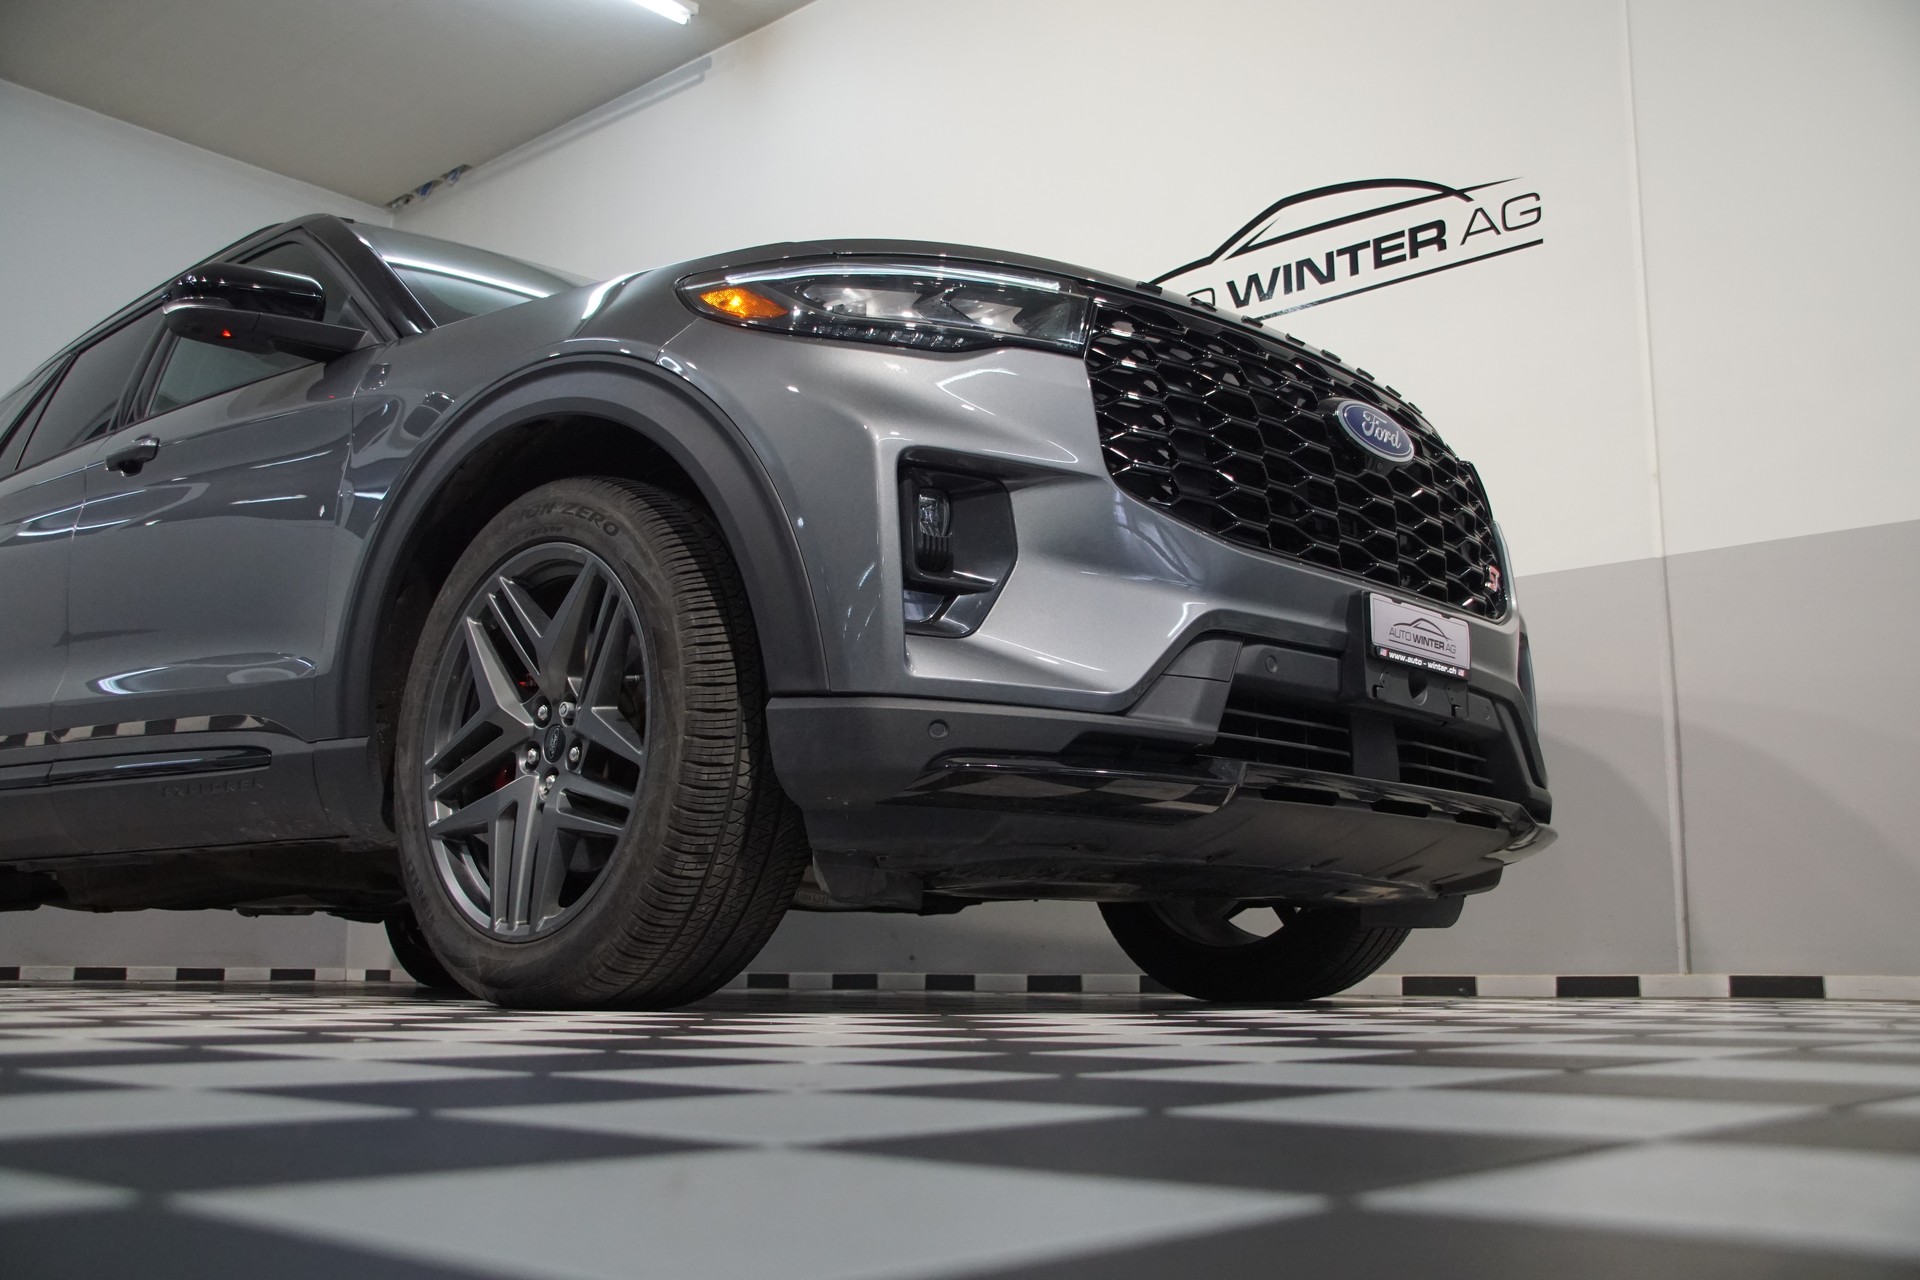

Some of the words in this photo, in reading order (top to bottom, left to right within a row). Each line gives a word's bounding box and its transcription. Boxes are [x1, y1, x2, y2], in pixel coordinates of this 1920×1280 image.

[1225, 219, 1447, 309] WINTER
[1459, 192, 1542, 246] AG
[1361, 410, 1402, 449] Ford
[561, 502, 620, 536] ZERO
[1389, 627, 1411, 642] AUTO
[1412, 633, 1445, 651] WINTER
[1446, 643, 1457, 654] AG
